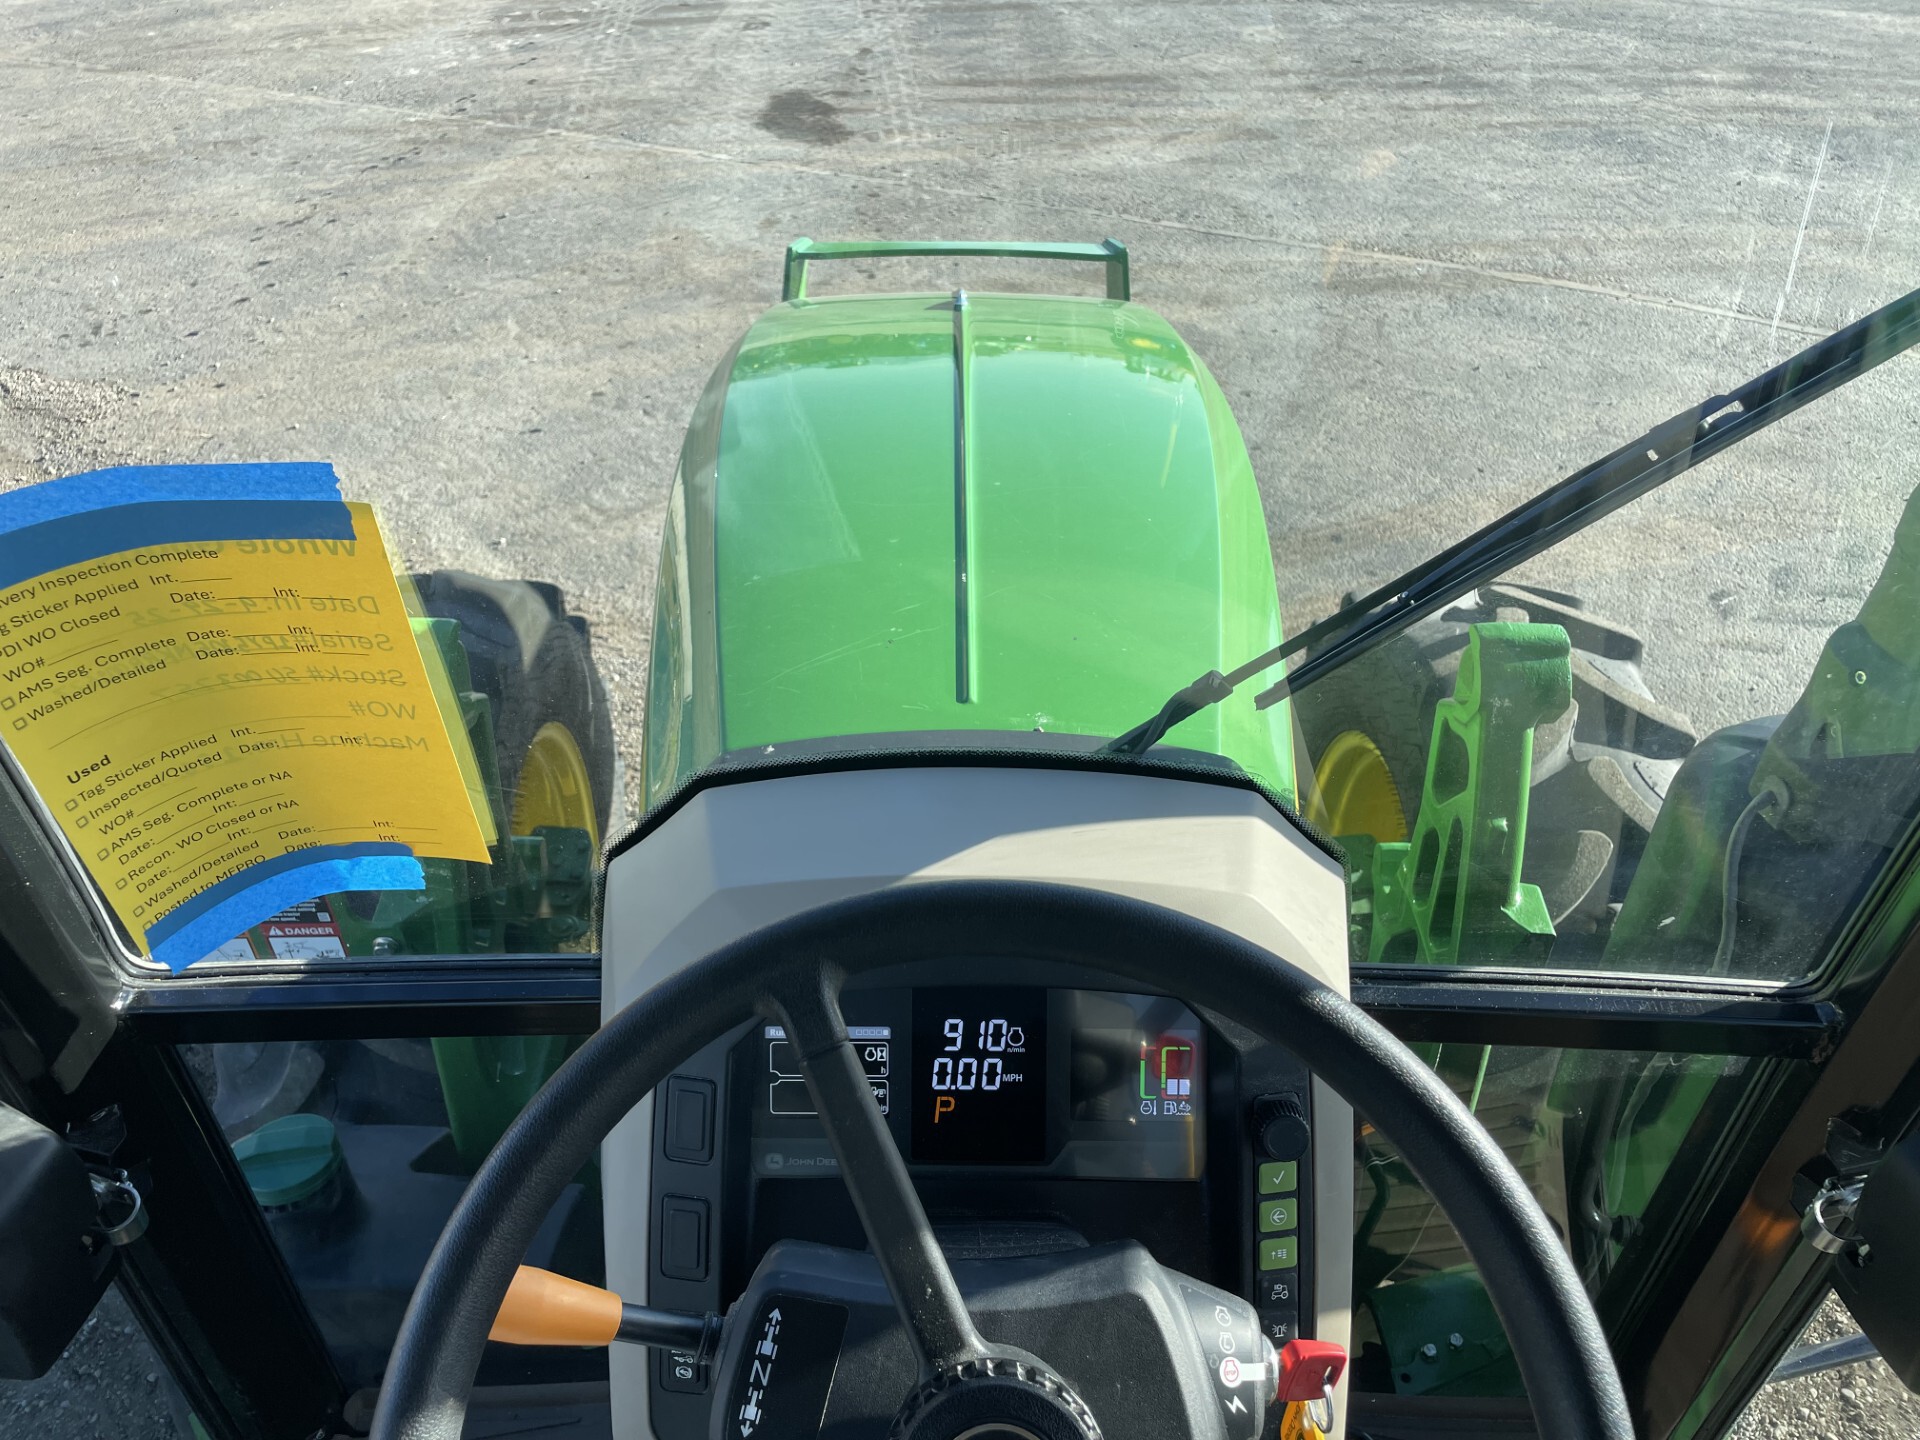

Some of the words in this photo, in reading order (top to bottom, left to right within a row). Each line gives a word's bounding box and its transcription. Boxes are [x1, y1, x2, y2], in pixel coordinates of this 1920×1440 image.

[38, 559, 132, 592] Inspection
[135, 547, 219, 566] Complete
[10, 600, 69, 628] Sticker
[74, 579, 140, 606] Applied
[149, 573, 179, 586] Int.
[22, 627, 56, 647] WO
[60, 606, 121, 633] Closed
[169, 589, 216, 604] Date:
[273, 586, 300, 598] Int:
[2, 656, 46, 683] WO#
[17, 678, 54, 703] AMS
[55, 663, 93, 684] Seg.
[94, 636, 178, 667] Complete
[186, 628, 232, 642] Date:
[287, 624, 314, 636] Int:
[26, 659, 167, 722] Washed/Detailed
[195, 646, 240, 661] Date:
[295, 643, 321, 653] Int:
[66, 754, 112, 785] Used
[77, 785, 106, 803] Tag
[104, 757, 156, 787] Sticker
[159, 734, 218, 762] Applied
[230, 727, 256, 738] Int.
[88, 751, 222, 820] Inspected/Quoted
[238, 740, 280, 754] Date:
[98, 809, 135, 836] WO#
[110, 827, 142, 852] AMS
[142, 811, 175, 831] Seg.
[176, 780, 249, 813] Complete
[251, 776, 268, 786] or
[269, 770, 293, 783] NA
[118, 838, 156, 866] Date:
[212, 799, 237, 814] Int:
[127, 849, 175, 881] Recon.
[175, 831, 203, 850] WO
[205, 810, 257, 835] Closed
[258, 804, 275, 815] or
[276, 799, 300, 811] NA
[135, 866, 172, 893] Date:
[227, 827, 252, 841] Int:
[144, 840, 260, 908] Washed/Detailed
[278, 824, 317, 840] Date:
[284, 926, 335, 936] DANGER
[931, 1057, 1003, 1091] 0.00
[1002, 1073, 1023, 1082] MPH
[934, 1096, 956, 1123] P
[816, 1157, 838, 1166] DEE
